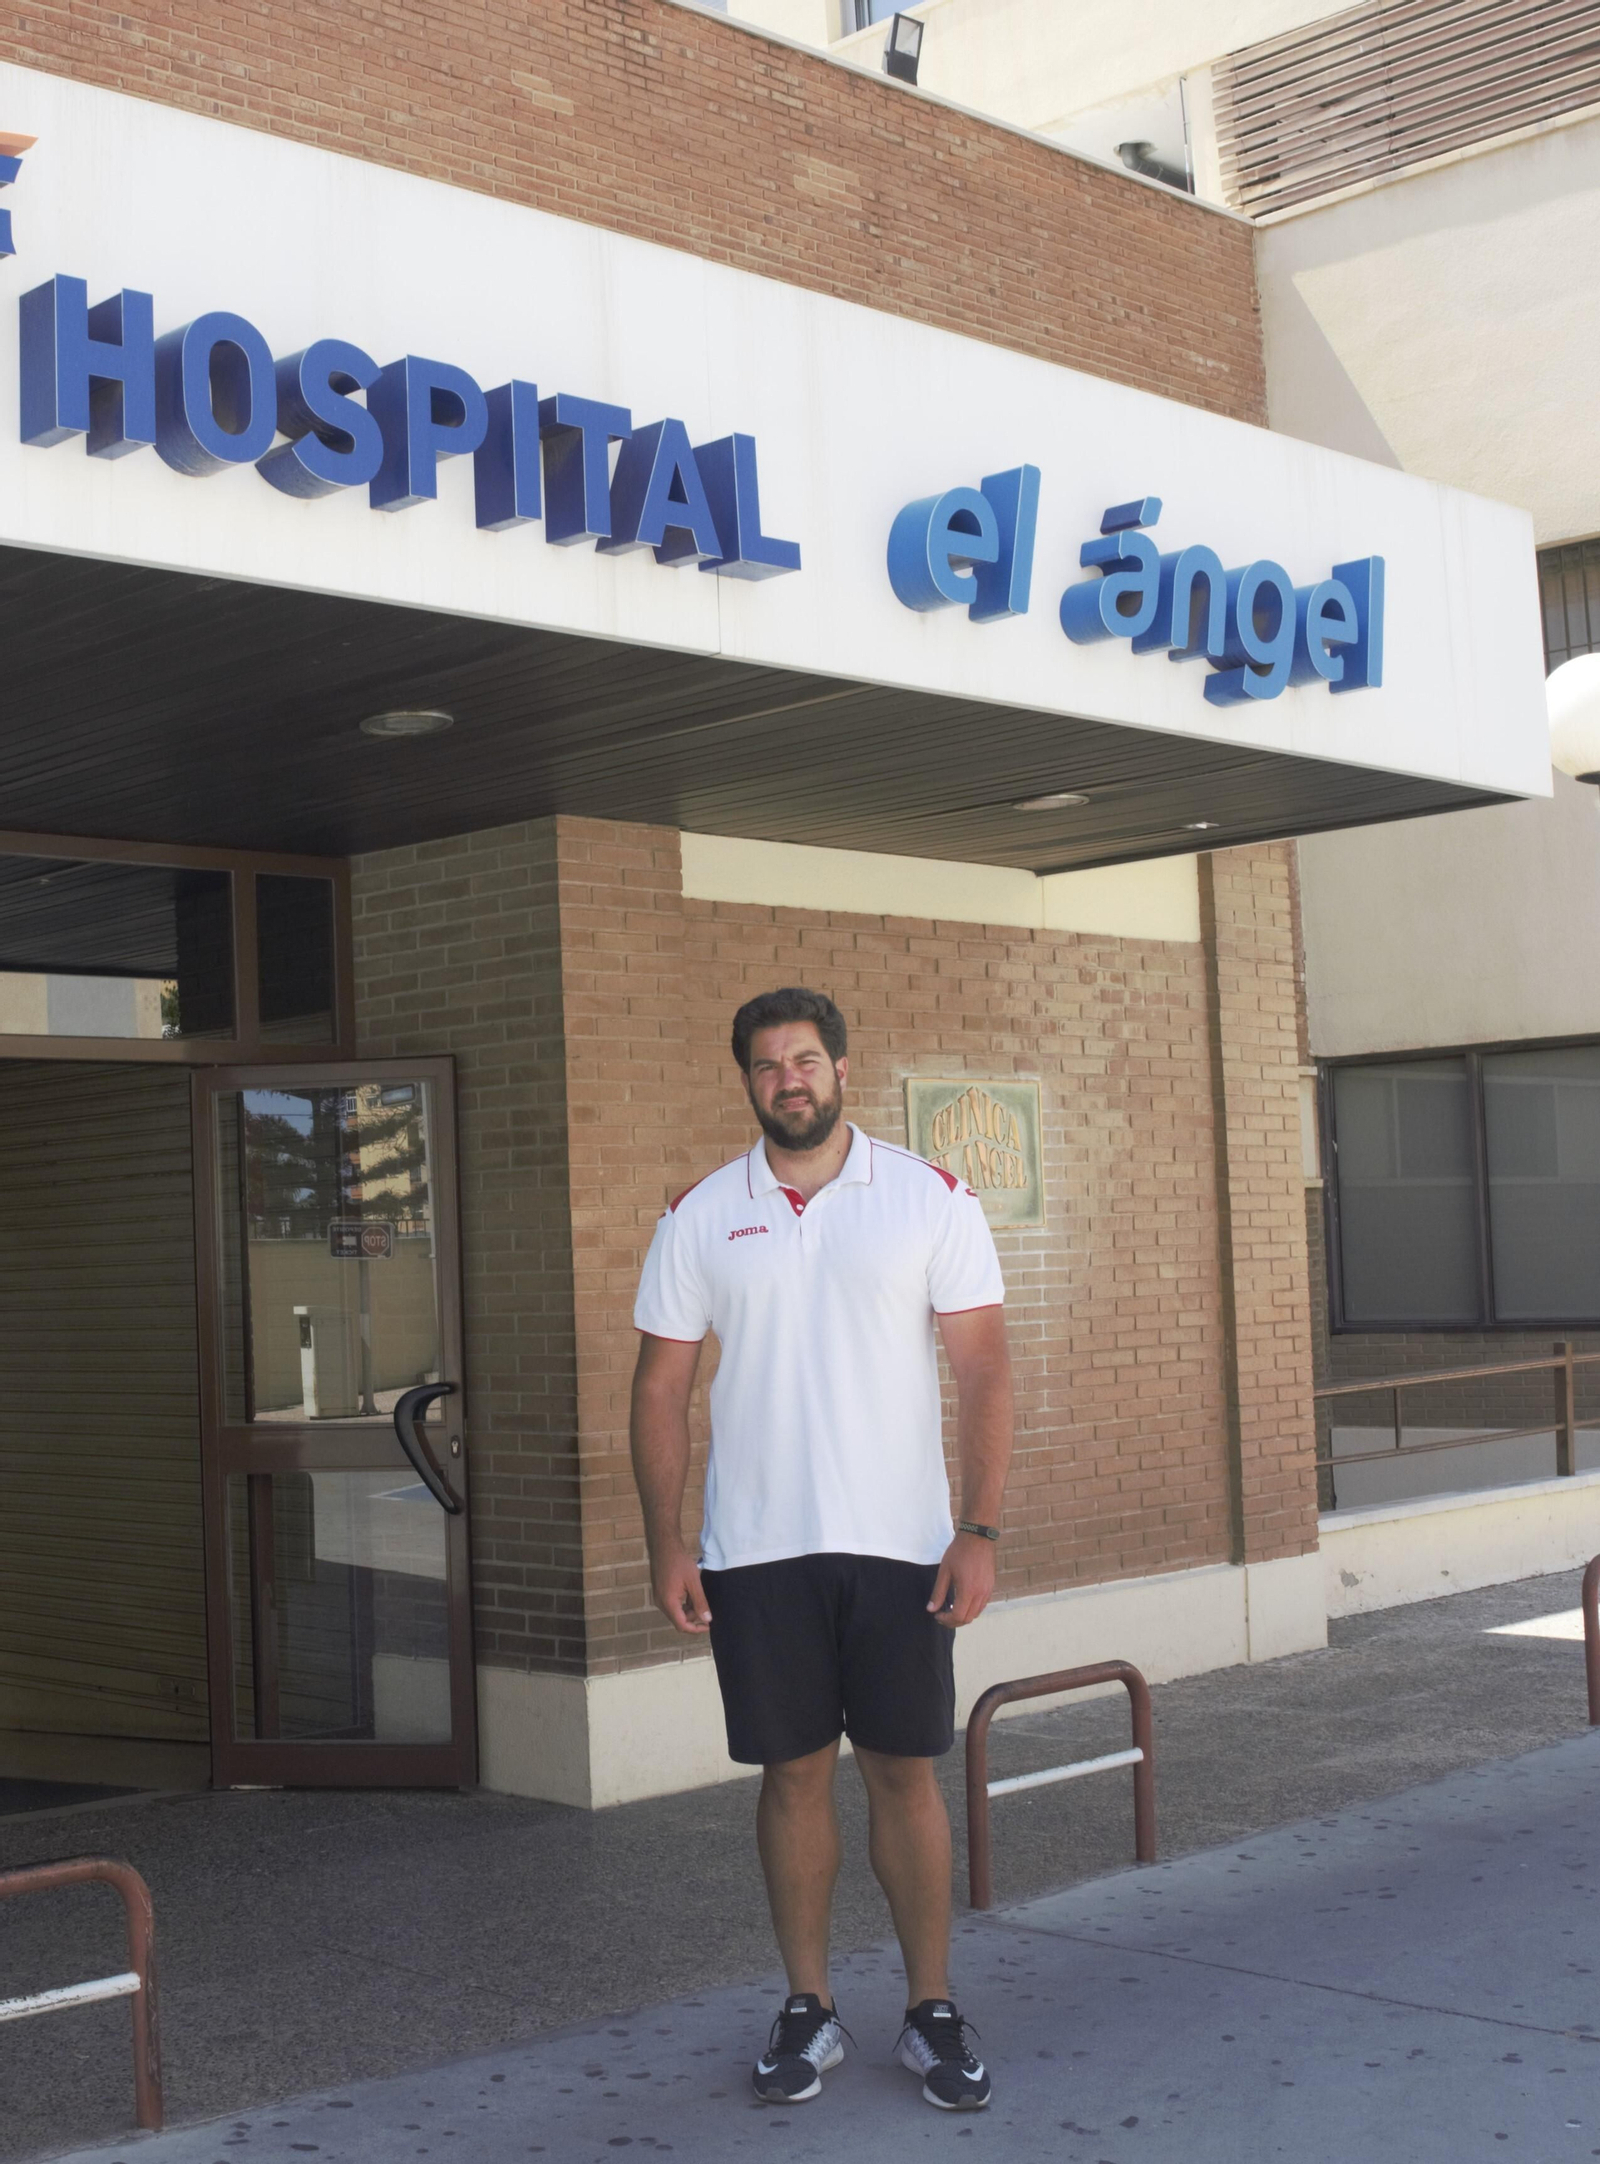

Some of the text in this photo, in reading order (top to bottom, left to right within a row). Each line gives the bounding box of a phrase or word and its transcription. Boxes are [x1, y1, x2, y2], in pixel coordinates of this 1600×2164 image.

[19, 273, 1385, 707] HOSPITAL el ángel
[932, 1086, 1021, 1152] CLINICA
